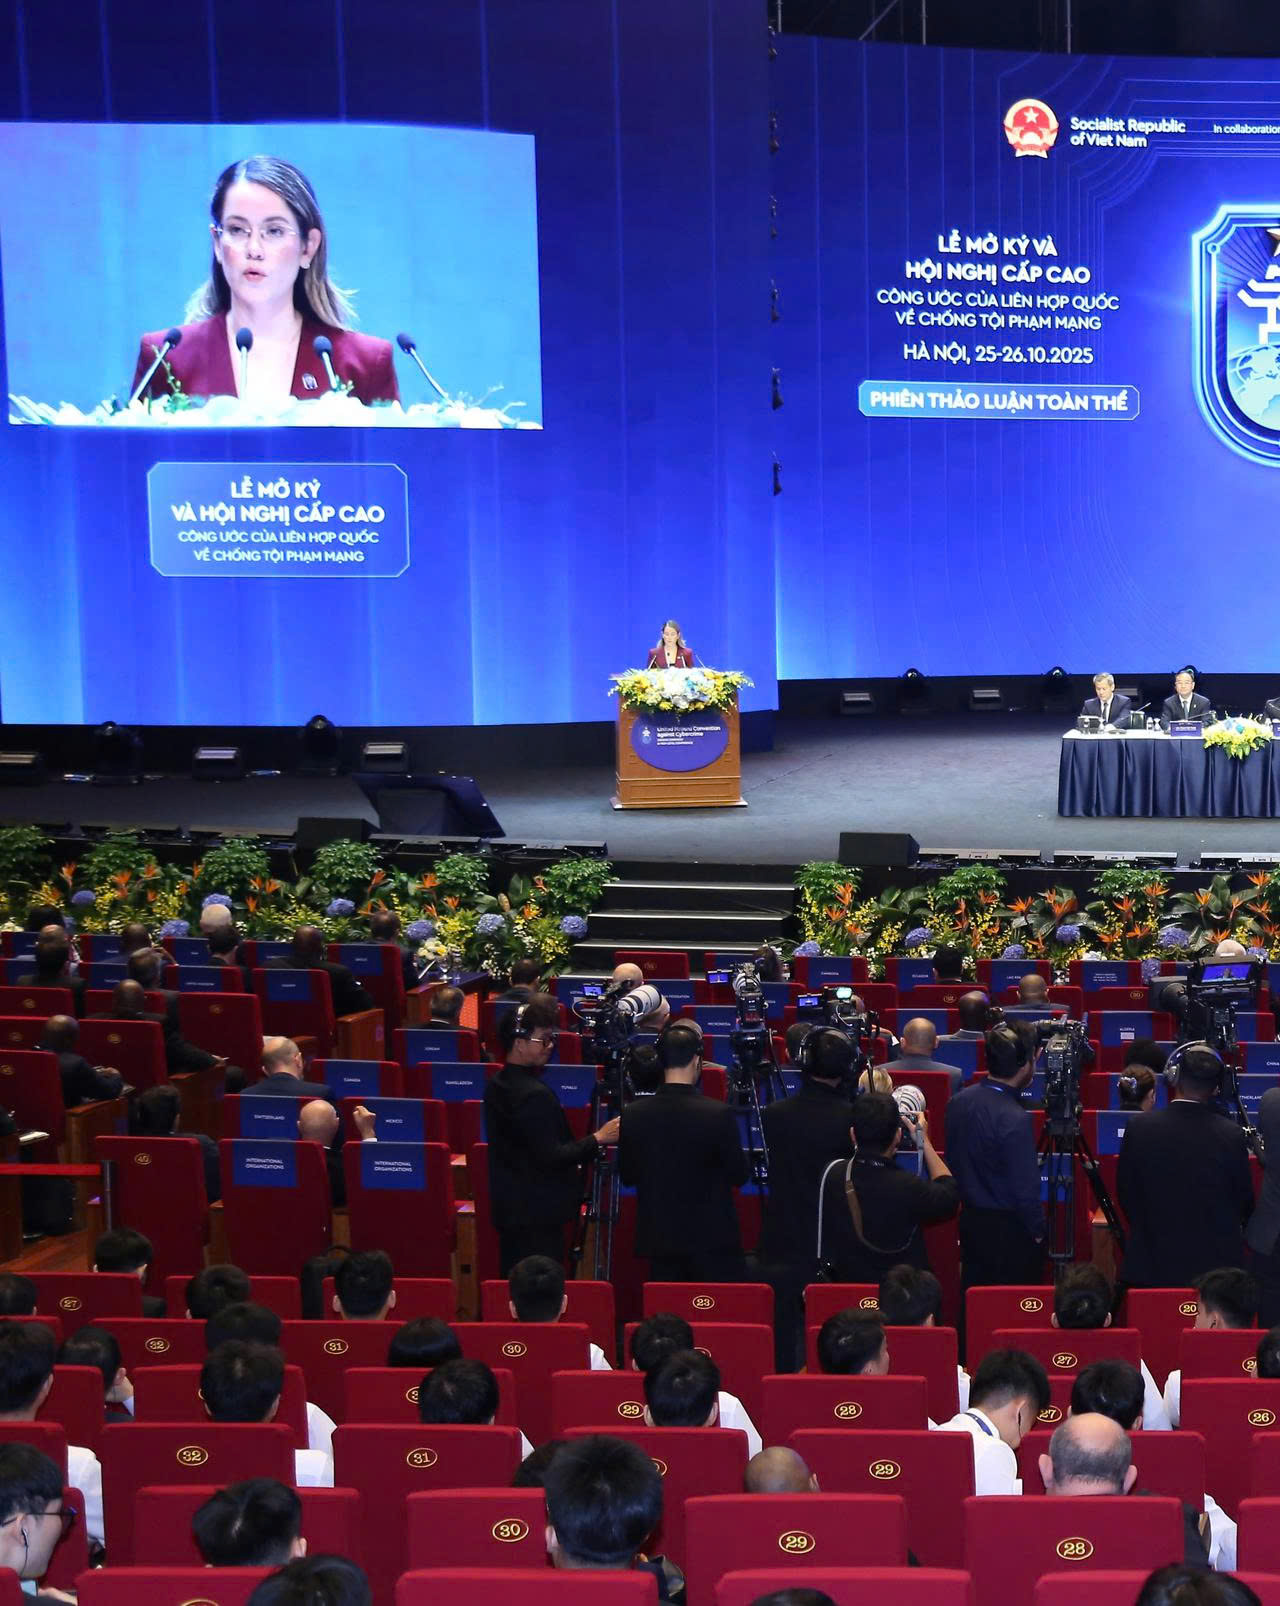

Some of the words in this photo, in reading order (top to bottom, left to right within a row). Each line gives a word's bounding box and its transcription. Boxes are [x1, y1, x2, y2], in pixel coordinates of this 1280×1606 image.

[1070, 116, 1126, 132] Socialist
[1128, 119, 1187, 135] Republic
[1213, 124, 1222, 133] In
[1070, 132, 1086, 146] of
[1087, 133, 1114, 147] Viet
[1116, 134, 1148, 148] Nam
[1003, 234, 1031, 255] KÝ
[1033, 235, 1058, 256] VÀ
[905, 258, 942, 283] HỘI
[947, 263, 998, 286] NGHỊ
[1001, 258, 1043, 283] CẤP
[1045, 266, 1091, 284] CAO
[876, 288, 924, 306] CÔNG
[965, 290, 999, 308] CỦA
[1001, 292, 1033, 309] LIÊN
[1072, 291, 1120, 312] QUỐC
[918, 308, 977, 327] CHỐNG
[979, 312, 1005, 331] TỘI
[1008, 314, 1052, 332] PHẠM
[1055, 315, 1102, 332] MẠNG
[903, 340, 930, 360] HÀ
[933, 341, 972, 365] NỘI,
[975, 345, 1094, 364] 25-26.10.2025
[870, 388, 925, 408] PHIÊN
[927, 388, 980, 409] THẢO
[984, 390, 1033, 414] LUẬN
[1035, 391, 1089, 411] TOÀN
[294, 478, 320, 499] KÝ
[171, 502, 197, 522] VÀ
[201, 503, 235, 526] HỘI
[241, 505, 290, 526] NGHỊ
[294, 500, 335, 522] CẤP
[338, 506, 385, 523] CAO
[178, 528, 217, 543] CÔNG
[251, 528, 278, 543] CỦA
[279, 529, 306, 543] LIÊN
[338, 529, 379, 546] QUỐC
[213, 547, 261, 562] CHỐNG
[263, 549, 284, 564] TỘI
[286, 550, 322, 564] PHẠM
[325, 550, 365, 564] MẠNG
[64, 1299, 77, 1308] 27
[696, 1298, 711, 1307] 23
[863, 1300, 878, 1309] 22
[1024, 1300, 1038, 1309] 21
[1183, 1304, 1197, 1313] 20
[149, 1340, 165, 1350] 32
[329, 1342, 343, 1351] 31
[507, 1345, 522, 1354] 30
[1056, 1356, 1072, 1365] 27
[622, 1404, 640, 1415] 29
[839, 1405, 857, 1416] 28
[1039, 1409, 1057, 1419] 27
[1252, 1412, 1269, 1423] 26
[182, 1450, 202, 1462] 32
[413, 1452, 430, 1464] 31
[875, 1464, 894, 1476] 29
[499, 1523, 521, 1537] 30
[785, 1535, 808, 1549] 29
[1063, 1542, 1086, 1556] 28
